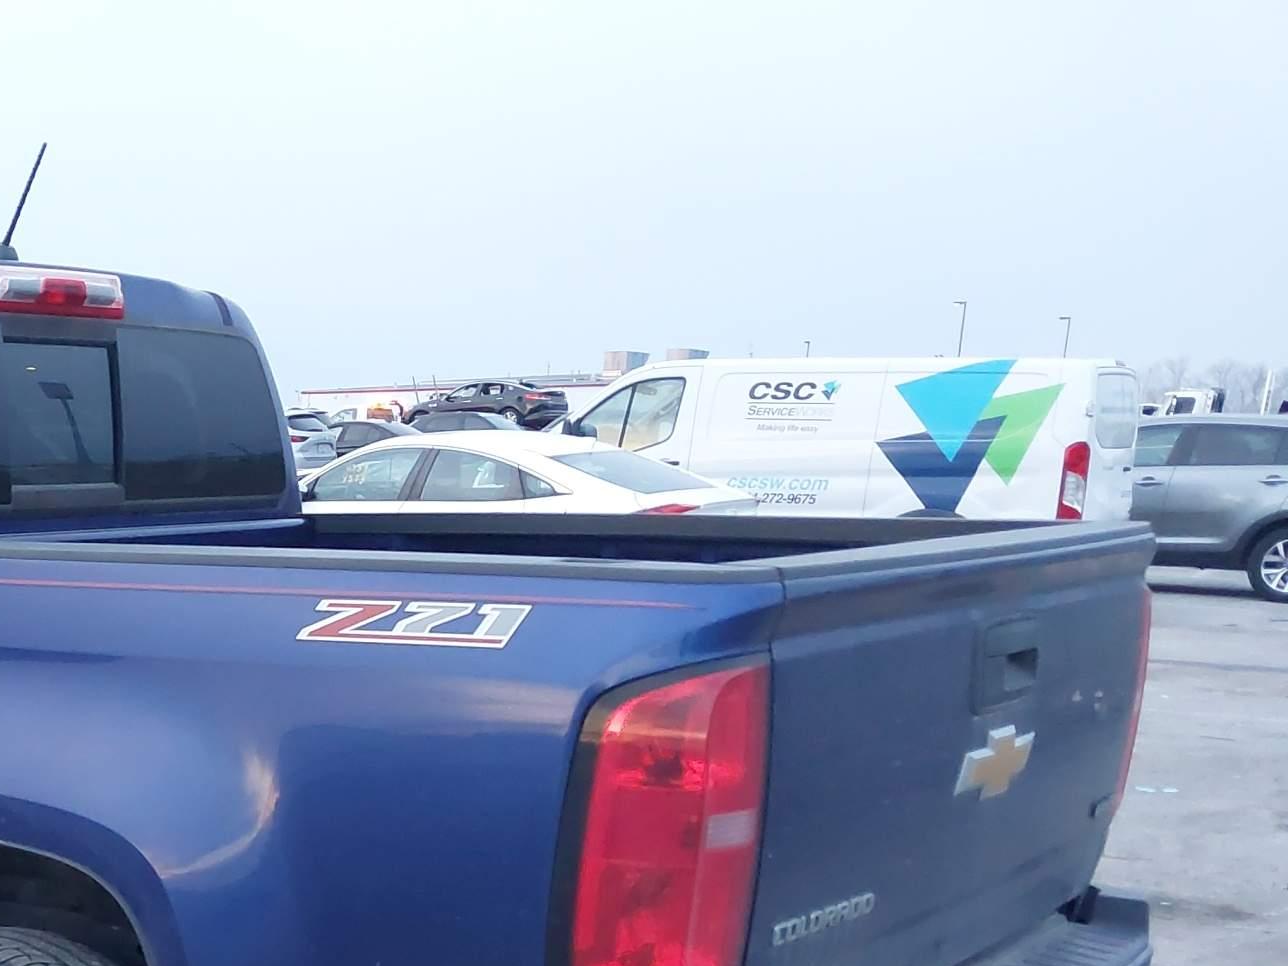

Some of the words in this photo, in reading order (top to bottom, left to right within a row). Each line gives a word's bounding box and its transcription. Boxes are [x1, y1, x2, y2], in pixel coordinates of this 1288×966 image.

[748, 382, 817, 400] CSC
[726, 477, 830, 491] cscsw.com
[296, 599, 532, 649] Z71
[773, 892, 875, 947] COLORADO
